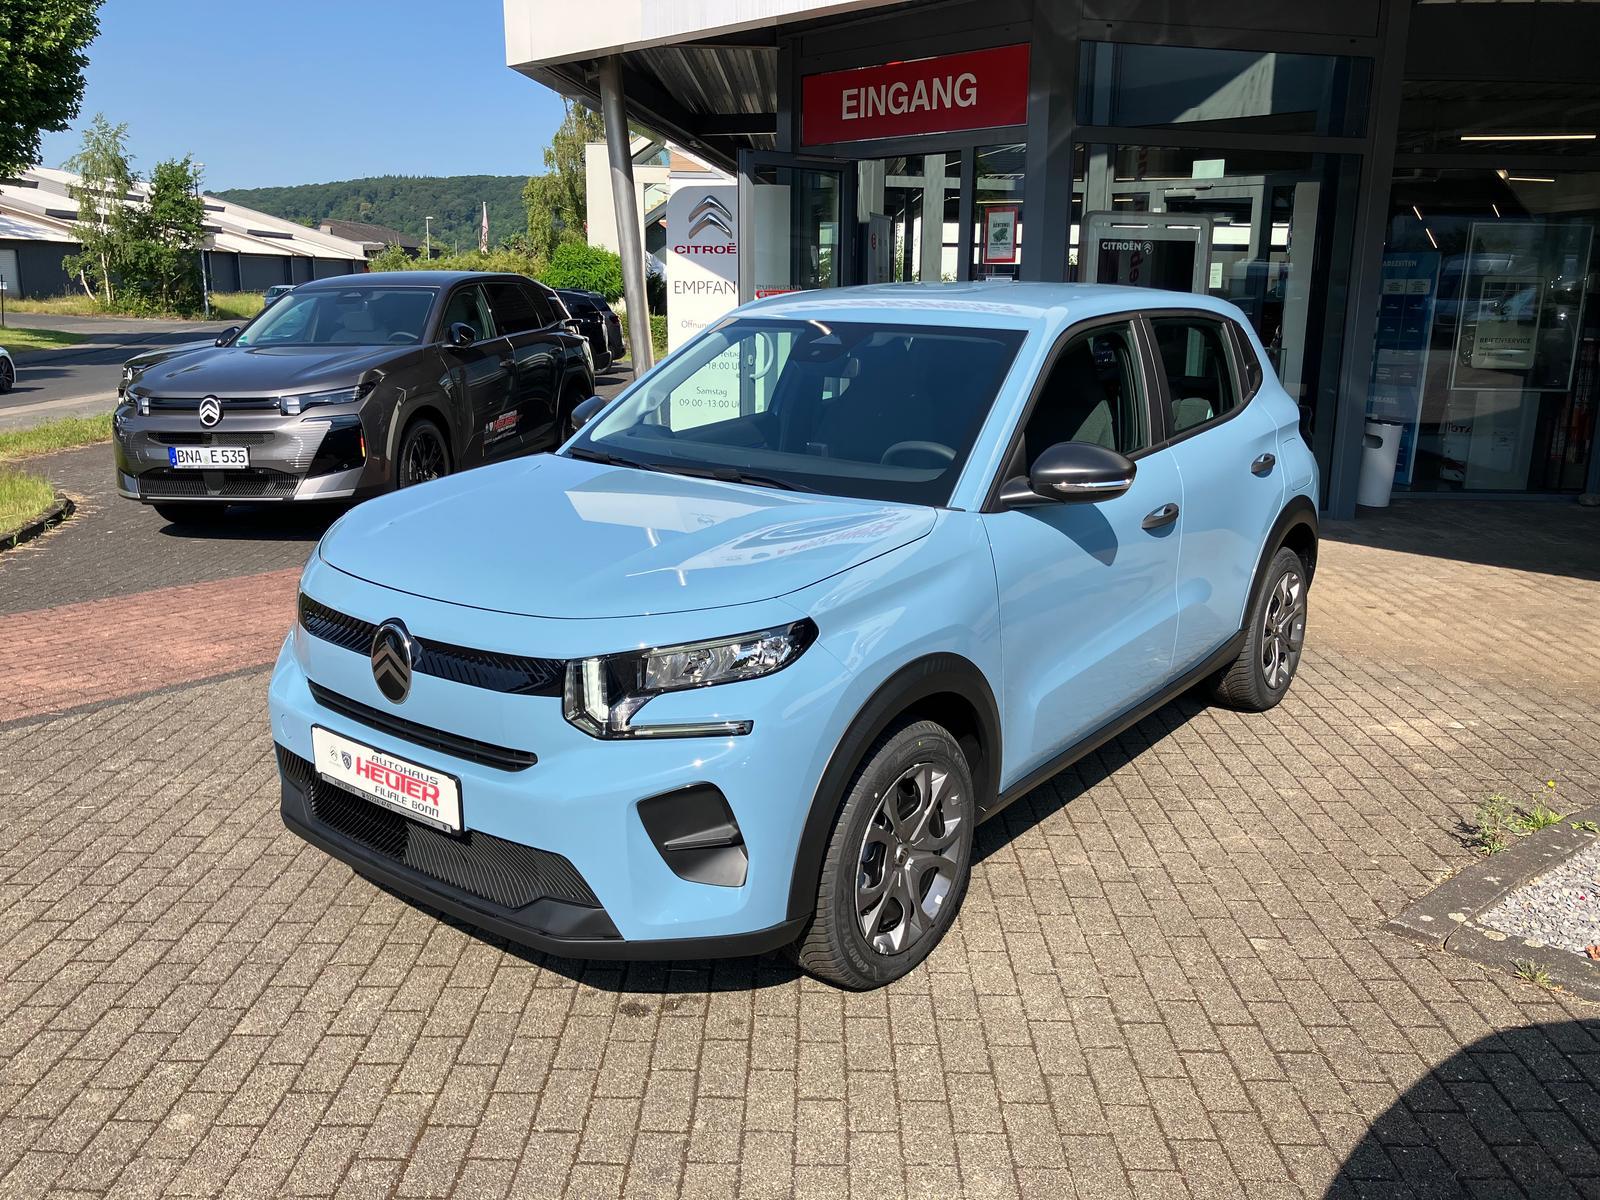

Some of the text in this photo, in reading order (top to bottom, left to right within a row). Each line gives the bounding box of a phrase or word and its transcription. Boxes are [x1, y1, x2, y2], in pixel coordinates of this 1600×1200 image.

[842, 72, 977, 120] EINGANG
[674, 242, 737, 254] CITROË
[1102, 240, 1141, 251] CITROËN
[674, 280, 737, 295] EMPFAN
[696, 386, 728, 397] Samstag
[177, 450, 246, 463] BNA E 535
[372, 754, 439, 785] AUTOHAUS
[356, 756, 440, 806] HEUTER
[374, 785, 408, 806] FILIALE
